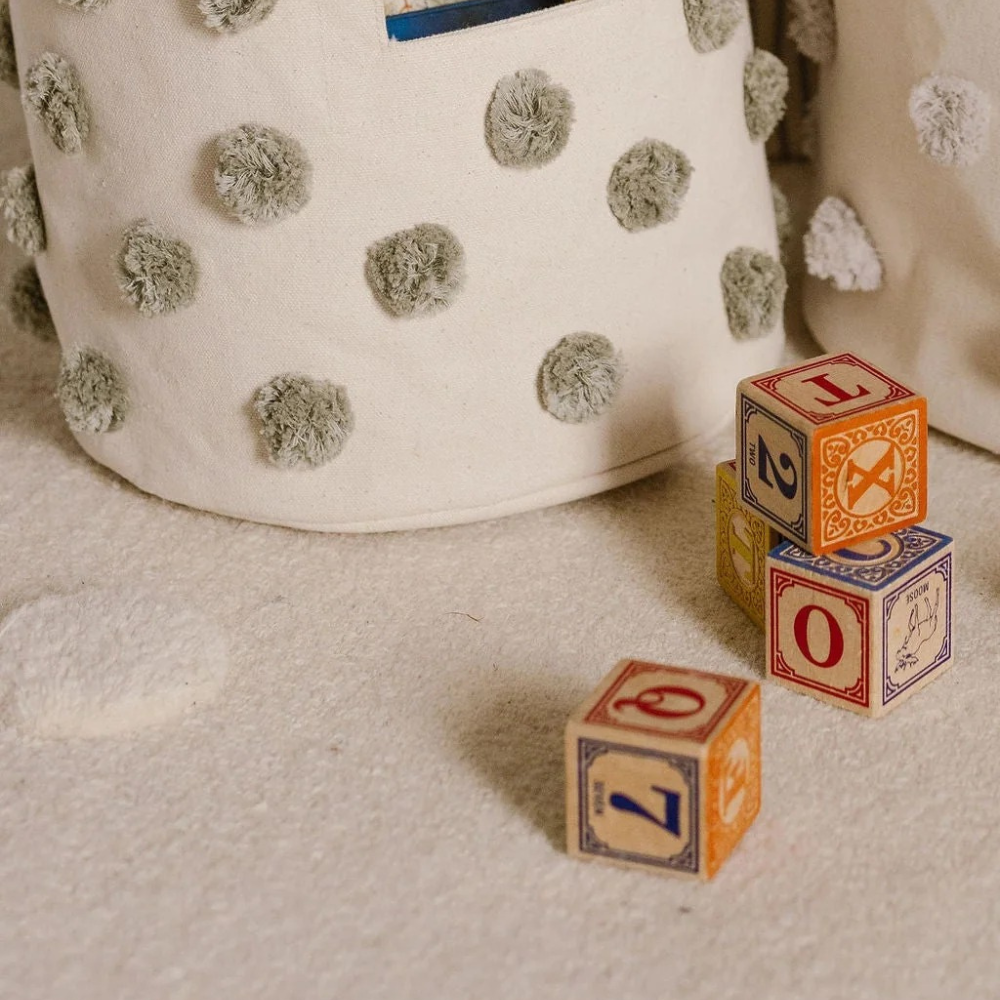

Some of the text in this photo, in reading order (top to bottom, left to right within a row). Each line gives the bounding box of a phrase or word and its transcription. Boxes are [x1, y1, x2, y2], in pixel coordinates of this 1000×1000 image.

[801, 373, 871, 407] T
[748, 442, 756, 467] TWO
[758, 434, 798, 499] 2
[847, 442, 895, 510] X
[613, 685, 706, 720] Q
[609, 785, 681, 838] 7
